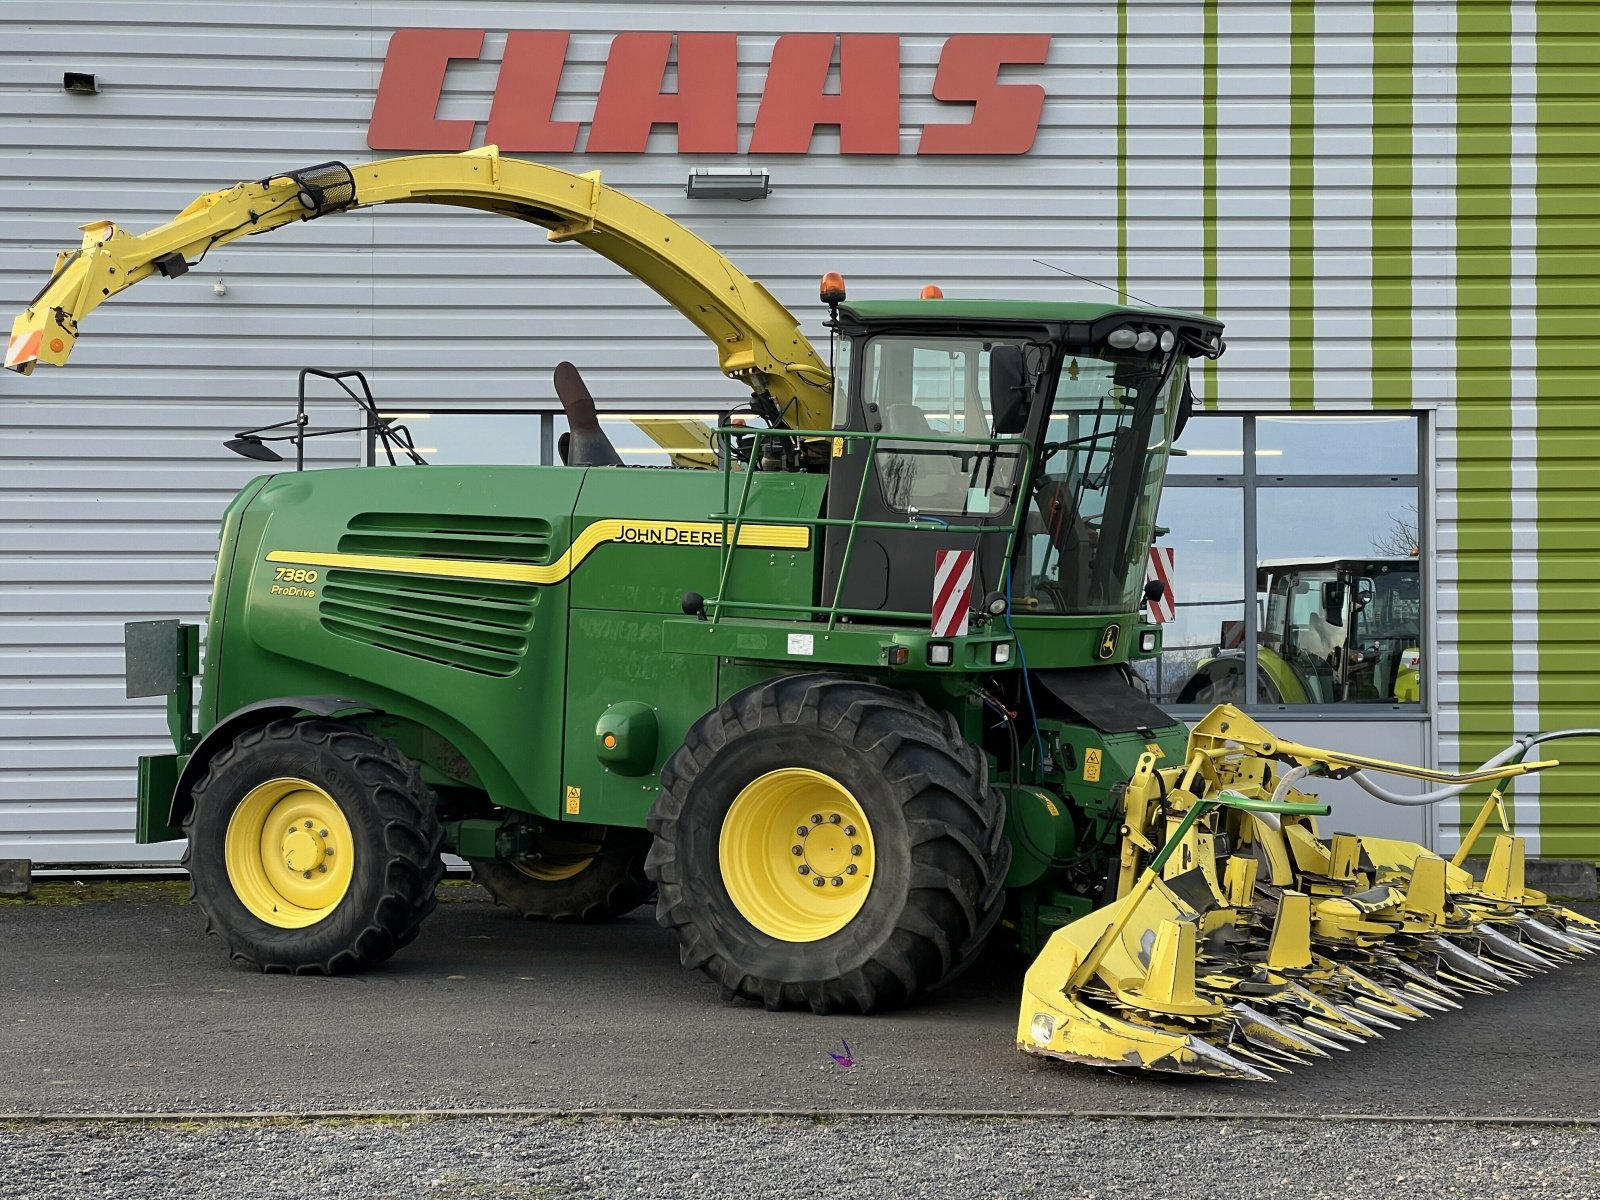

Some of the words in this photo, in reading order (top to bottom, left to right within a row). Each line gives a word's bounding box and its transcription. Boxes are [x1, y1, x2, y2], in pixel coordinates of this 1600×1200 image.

[367, 28, 1051, 155] CLAAS
[614, 525, 661, 541] JOHN
[665, 527, 722, 544] DEERE
[273, 567, 318, 584] 7380
[270, 585, 316, 598] ProDrive
